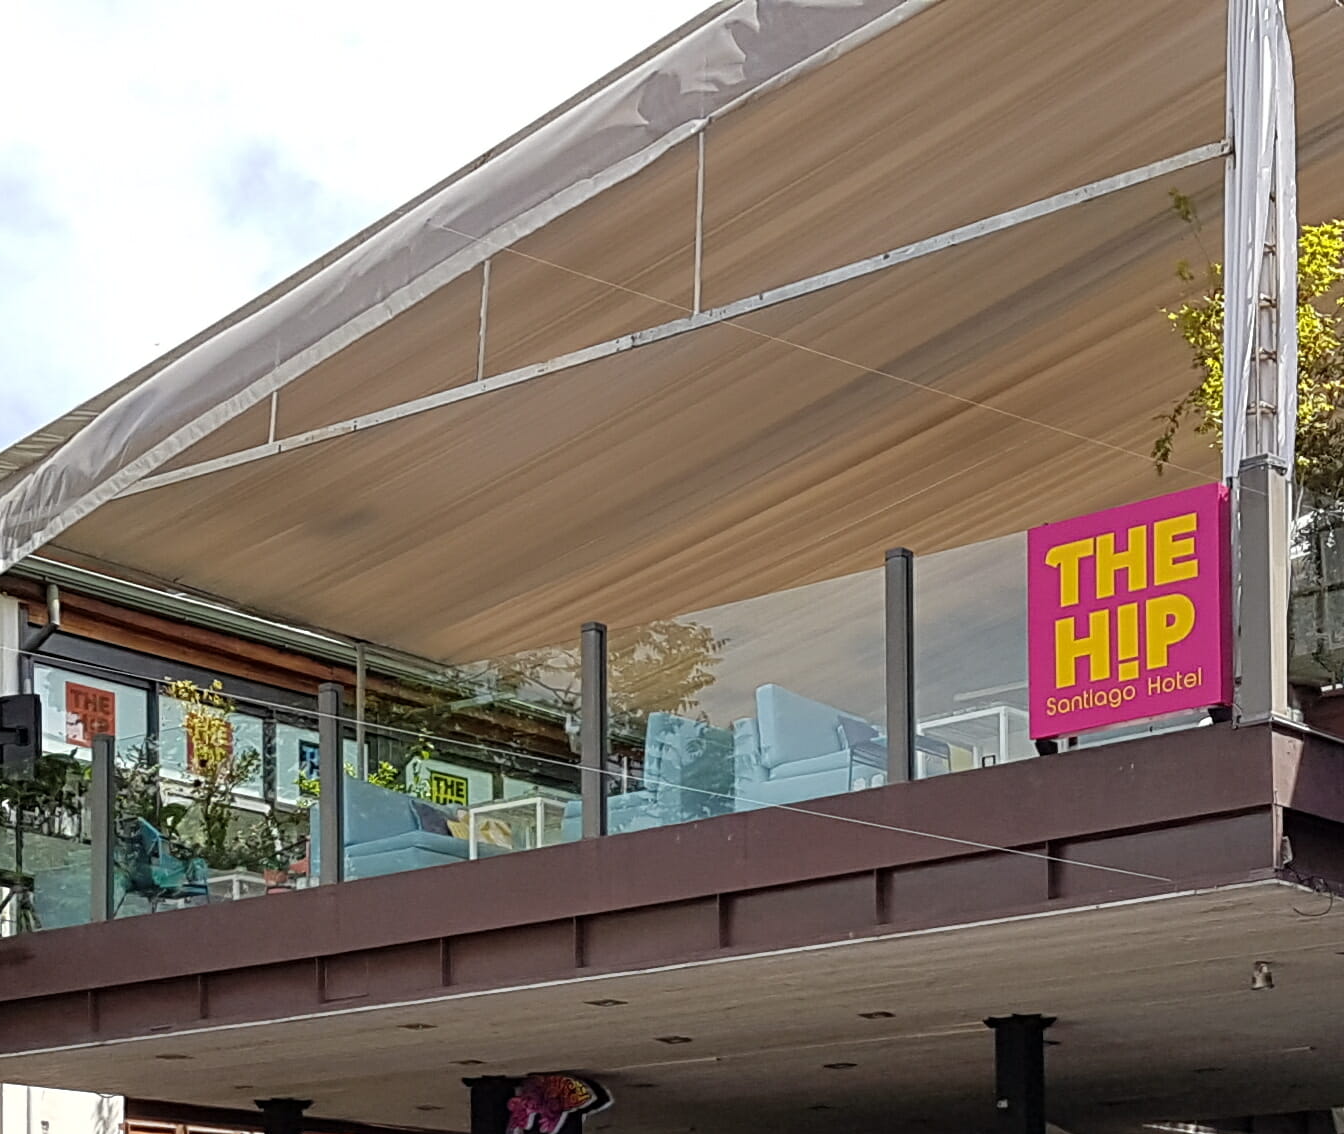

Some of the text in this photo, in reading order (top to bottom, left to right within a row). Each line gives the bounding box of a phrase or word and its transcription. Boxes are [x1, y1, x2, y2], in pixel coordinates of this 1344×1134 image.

[1045, 512, 1199, 608] THE
[70, 688, 111, 716] THE
[1046, 667, 1202, 716] Santiago Hotel
[433, 776, 465, 799] THE
